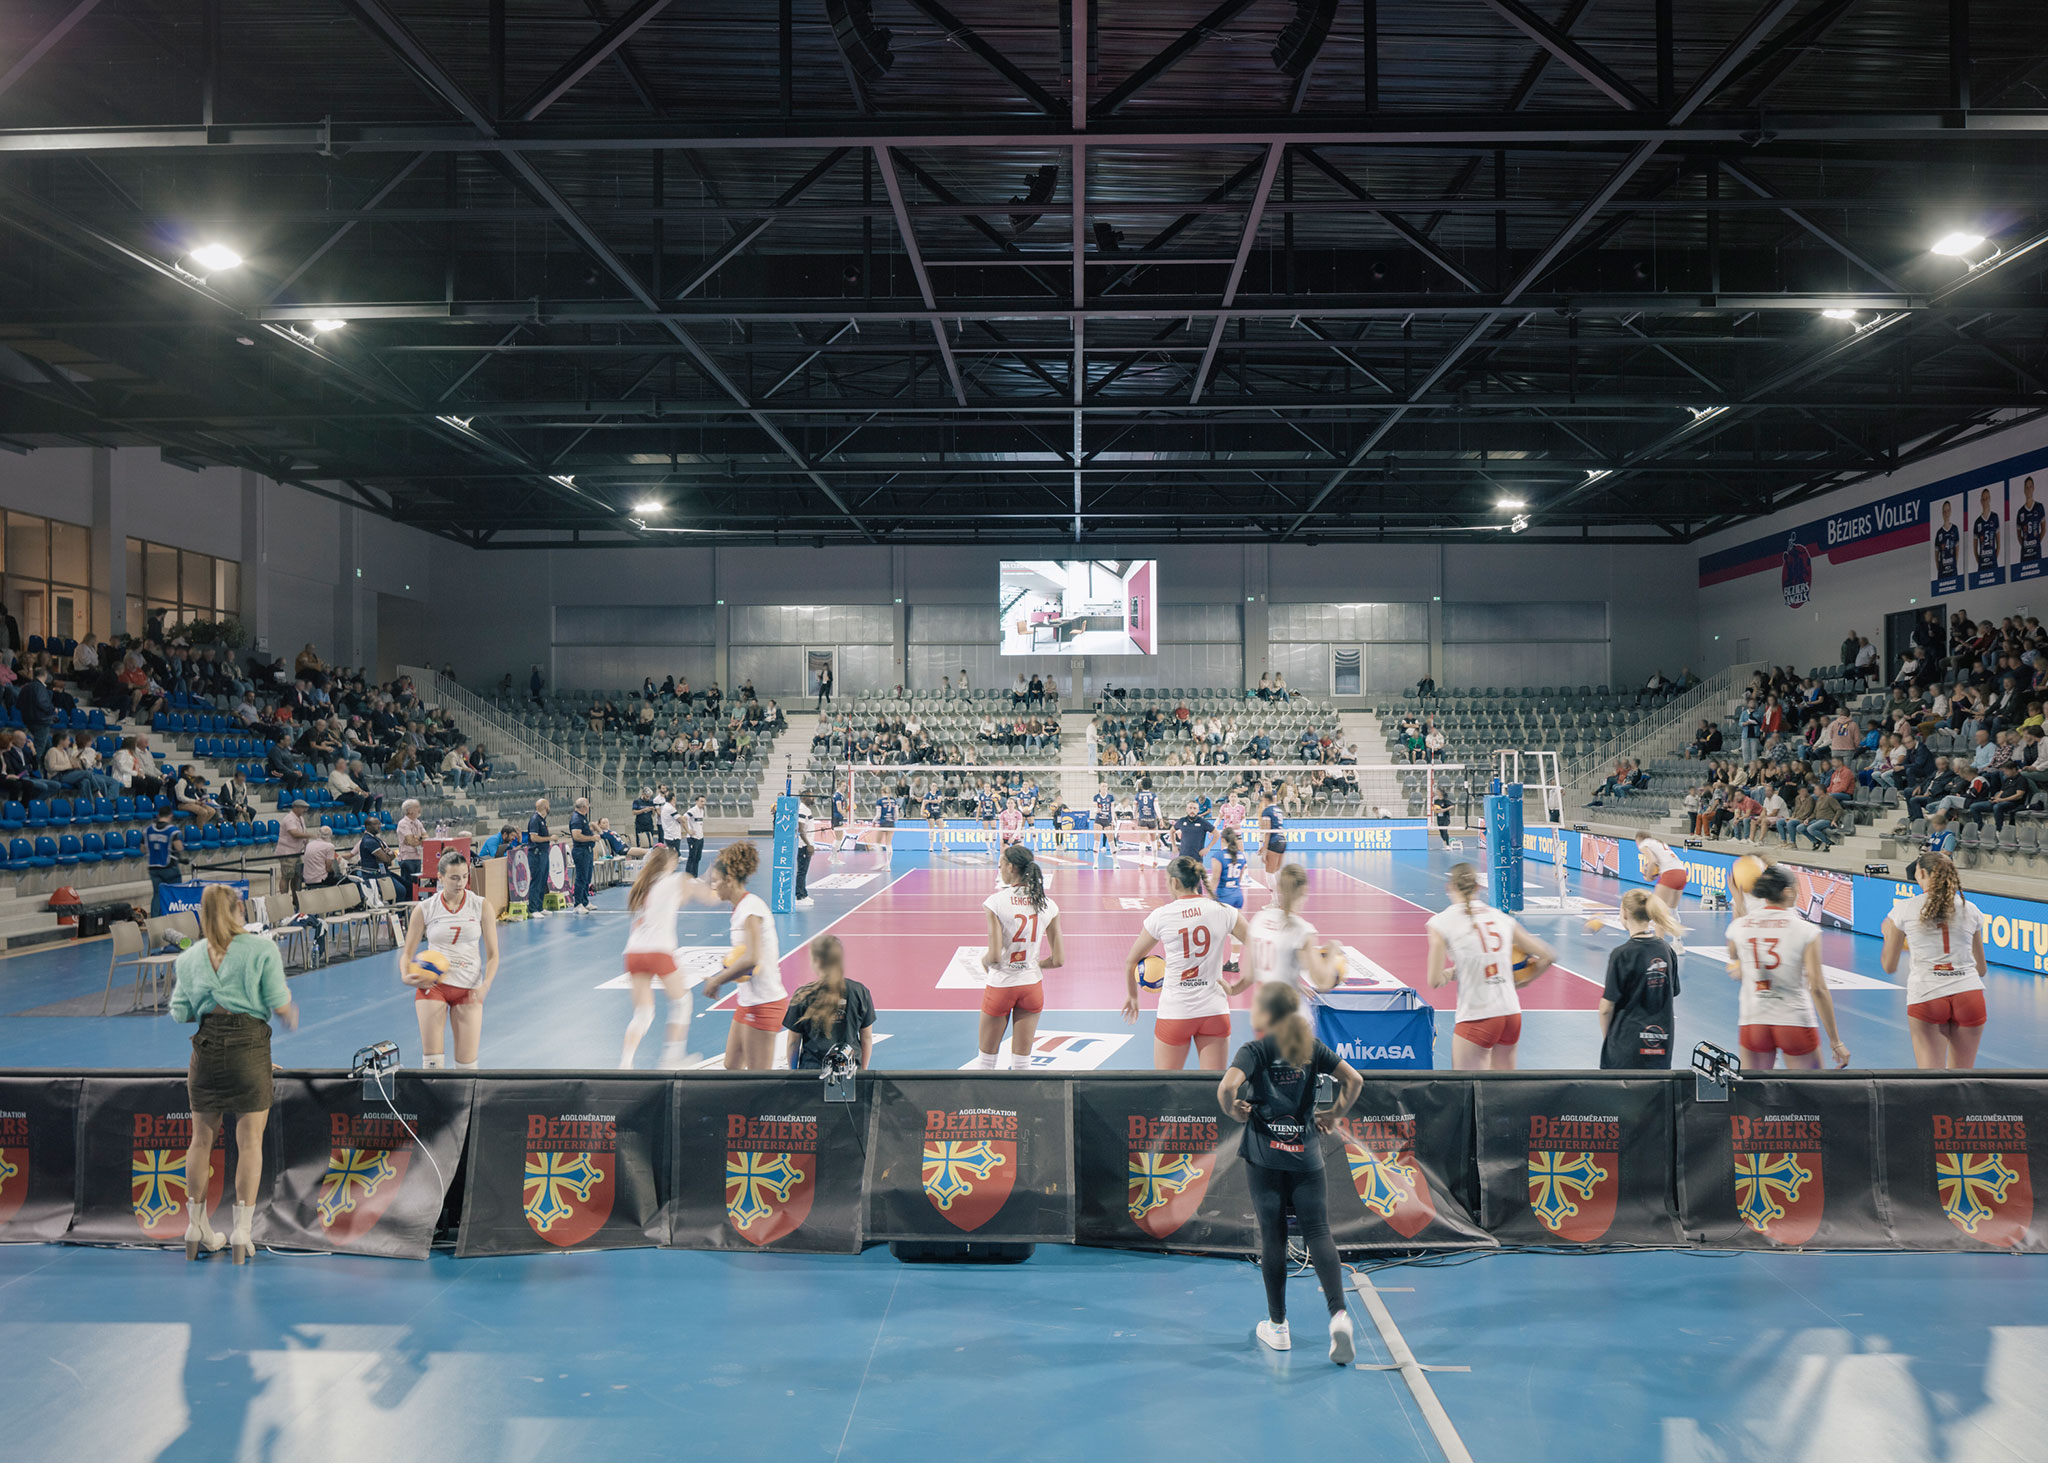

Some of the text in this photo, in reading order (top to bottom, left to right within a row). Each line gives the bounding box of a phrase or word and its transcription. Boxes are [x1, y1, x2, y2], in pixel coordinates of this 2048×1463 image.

[1828, 500, 1920, 545] BÉZIERS VOLLEY
[1143, 795, 1149, 805] 8
[1316, 829, 1392, 843] TOITURES
[1354, 841, 1392, 849] BEZIERS
[1227, 863, 1242, 879] 16
[450, 926, 461, 944] 7
[1012, 913, 1038, 943] 21
[1178, 925, 1211, 959] 19
[1475, 921, 1503, 953] 15
[1936, 922, 1950, 954] 1
[1748, 937, 1780, 970] 13
[1336, 1038, 1416, 1060] MIKASA
[560, 1113, 616, 1122] AGGLOMÉRATION
[760, 1114, 817, 1122] AGGLOMÉRATION
[959, 1108, 1017, 1117] AGGLOMÉRATION
[1160, 1115, 1217, 1123] AGGLOMÉRATION
[1560, 1114, 1619, 1122] AGGLOMÉRATION
[1764, 1113, 1820, 1122] AGGLOMÉRATION
[1965, 1114, 2023, 1122] AGGLOMÉRATION
[527, 1114, 617, 1140] BÉZIERS
[727, 1114, 818, 1140] BÉZIERS
[925, 1110, 1018, 1131] BÉZIERS
[1128, 1115, 1218, 1140] BÉZIERS
[1529, 1115, 1620, 1140] BÉZIERS
[1730, 1115, 1822, 1140] BÉZIERS
[1932, 1114, 2027, 1140] BÉZIERS
[924, 1129, 1018, 1140] MÉDITERRANÉE
[526, 1139, 617, 1150] MÉDITERRANÉE
[727, 1139, 817, 1151] MÉDITERRANÉE
[1128, 1139, 1218, 1151] MÉDITERRANÉE
[1528, 1138, 1619, 1150] MÉDITERRANÉE
[1732, 1139, 1823, 1151] MÉDITERRANÉE
[1934, 1139, 2028, 1151] MÉDITERRANÉE
